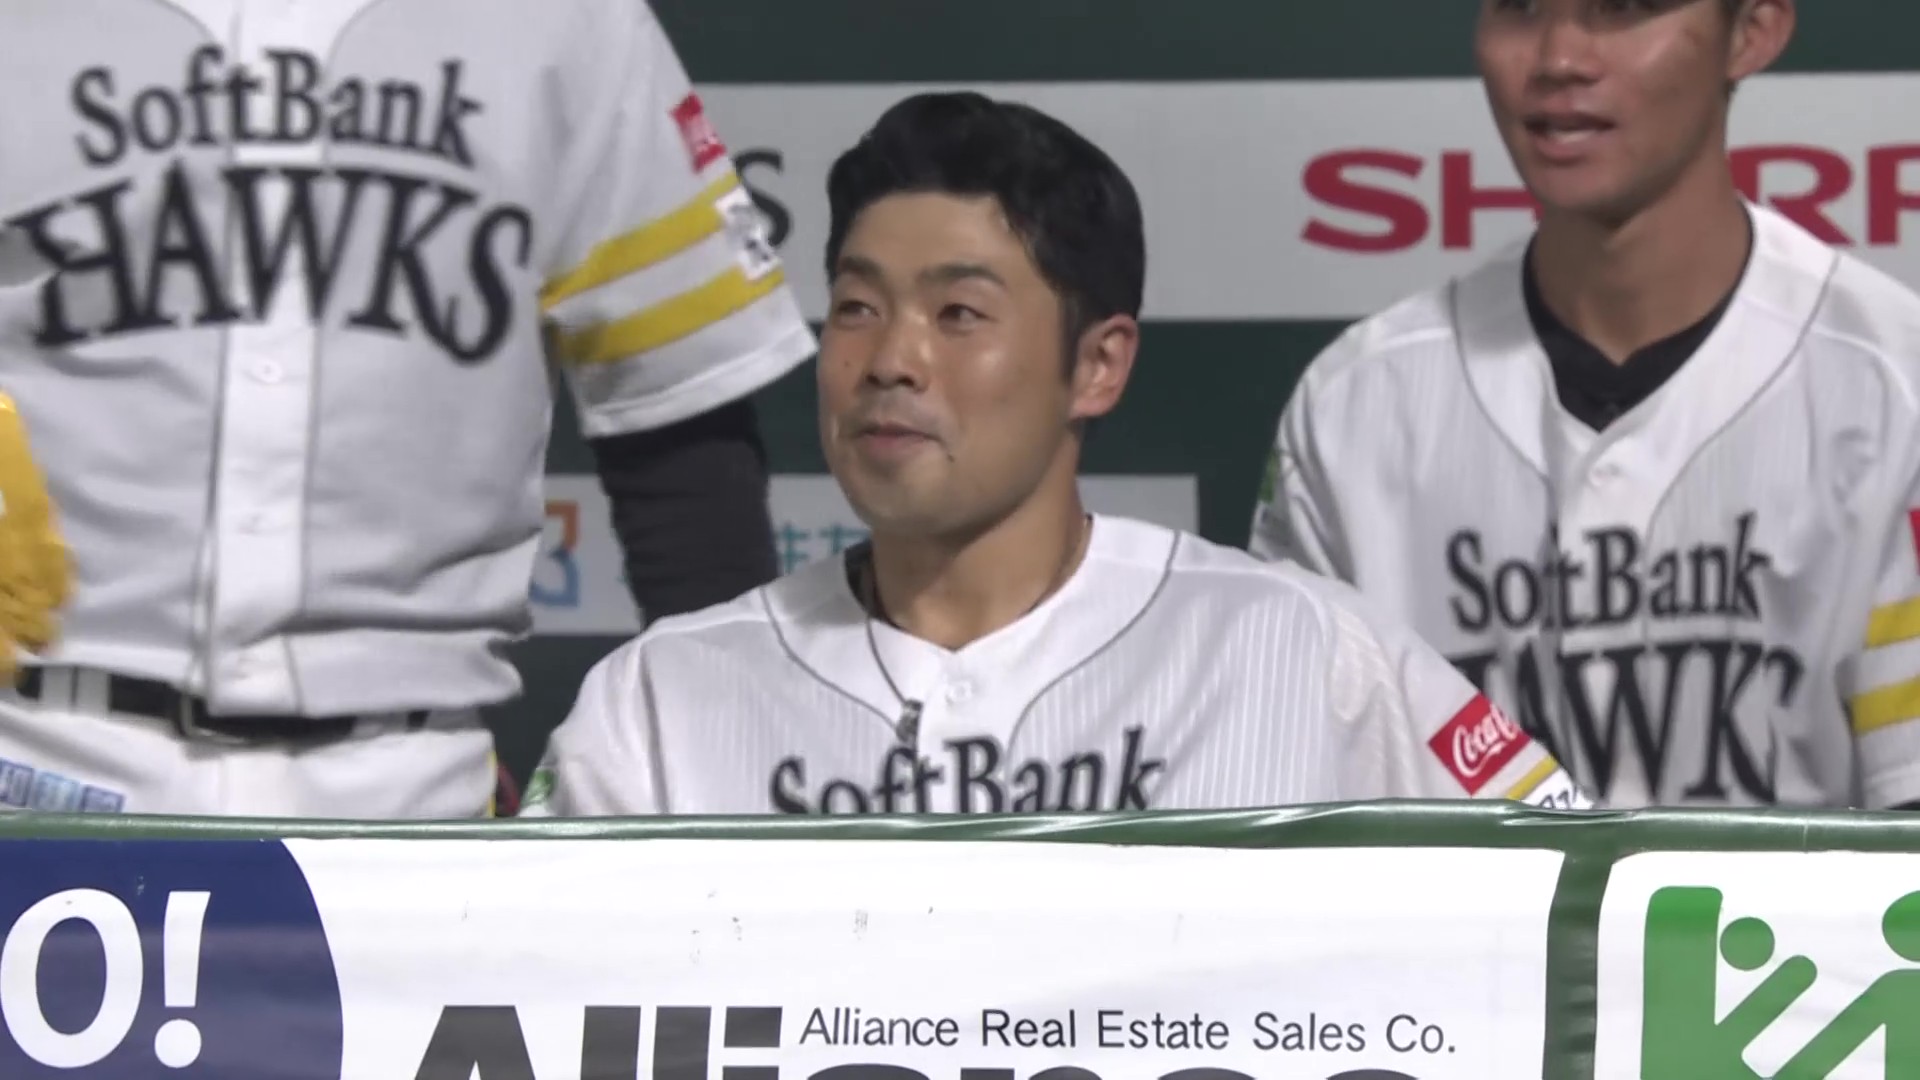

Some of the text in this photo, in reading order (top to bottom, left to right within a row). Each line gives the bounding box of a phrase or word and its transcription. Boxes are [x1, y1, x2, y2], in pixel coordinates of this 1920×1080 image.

[70, 43, 483, 169] SoftBank
[4, 160, 532, 364] HAWKS
[799, 1006, 1456, 1053] Alliance Real Estate Sales Co.
